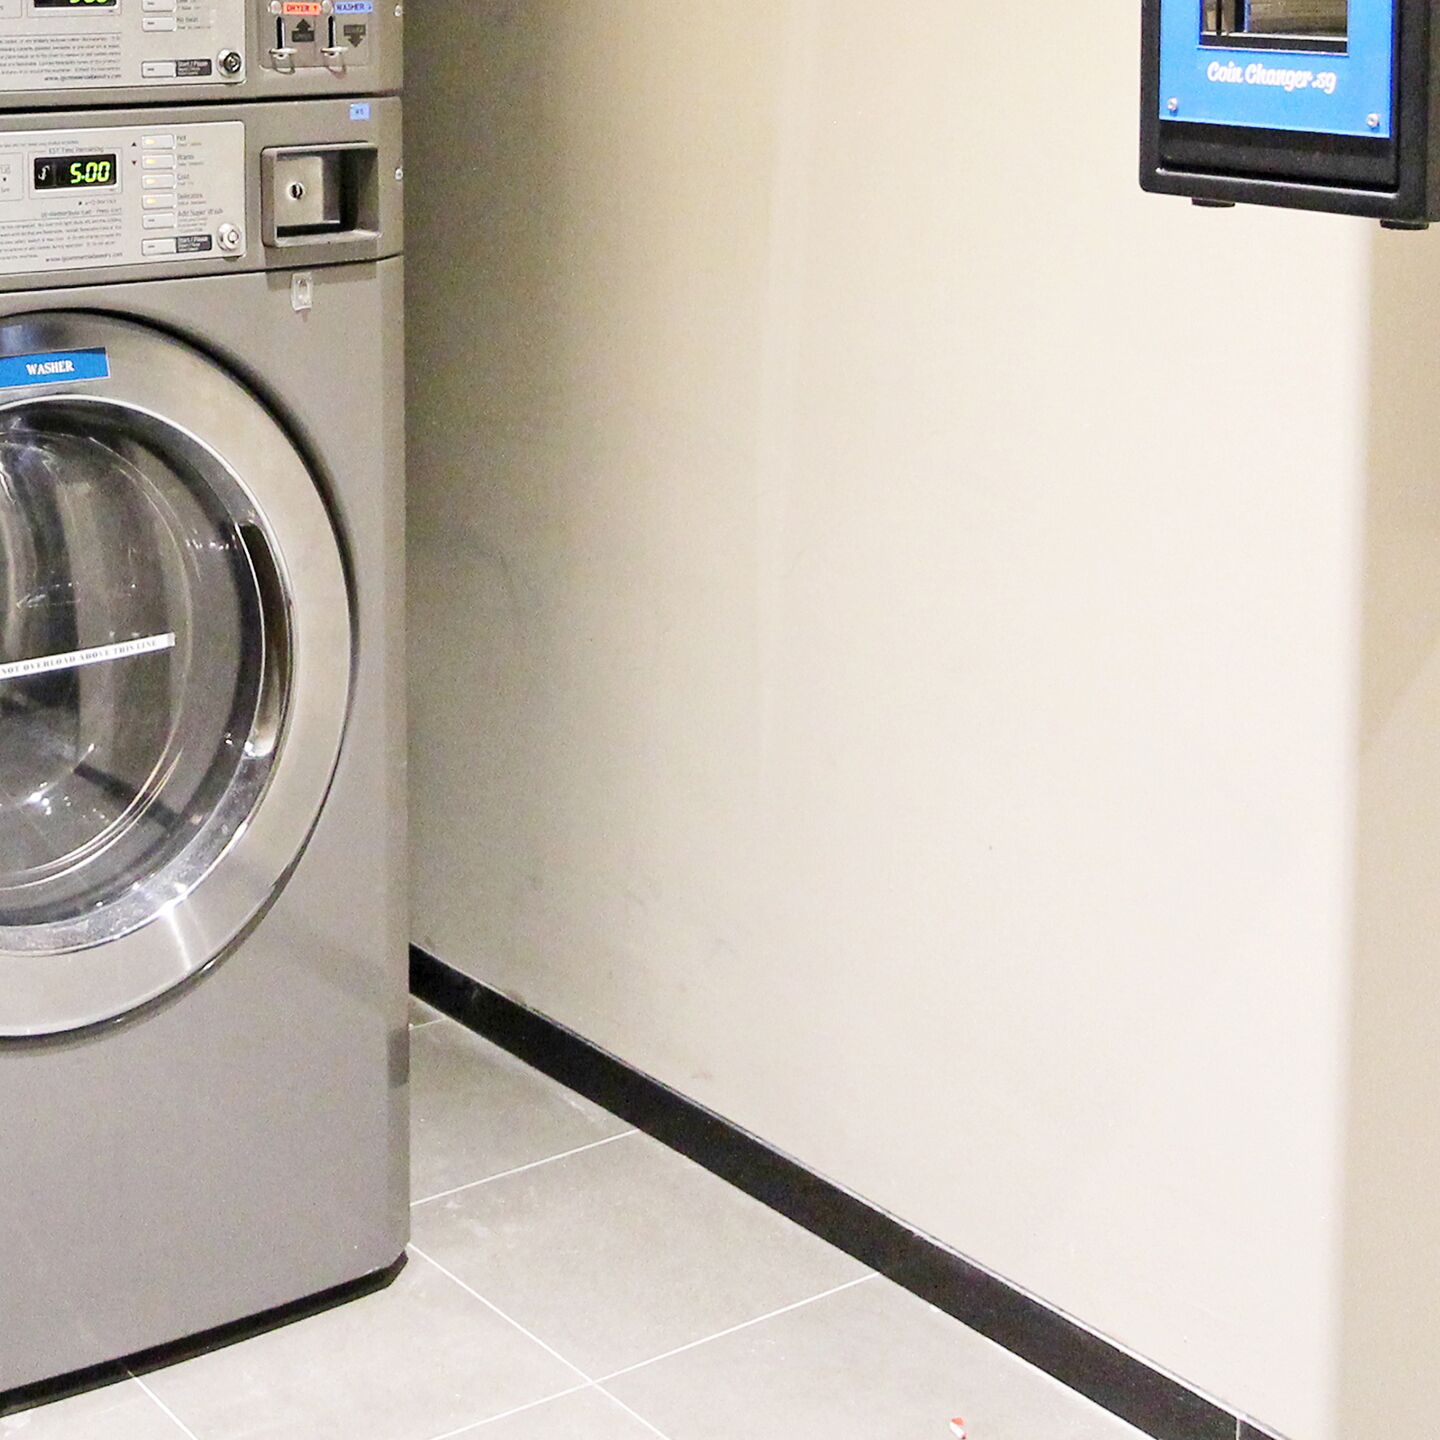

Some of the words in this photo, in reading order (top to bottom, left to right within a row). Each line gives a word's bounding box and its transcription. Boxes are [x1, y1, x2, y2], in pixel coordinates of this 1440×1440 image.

[1207, 61, 1244, 84] Coin
[70, 161, 111, 184] 5.00
[26, 360, 75, 376] WASHER
[2, 665, 20, 675] NOT
[23, 655, 77, 672] OVERLOAD
[79, 650, 110, 661] ABOVE
[113, 645, 135, 656] THIS
[136, 639, 158, 651] LINE
